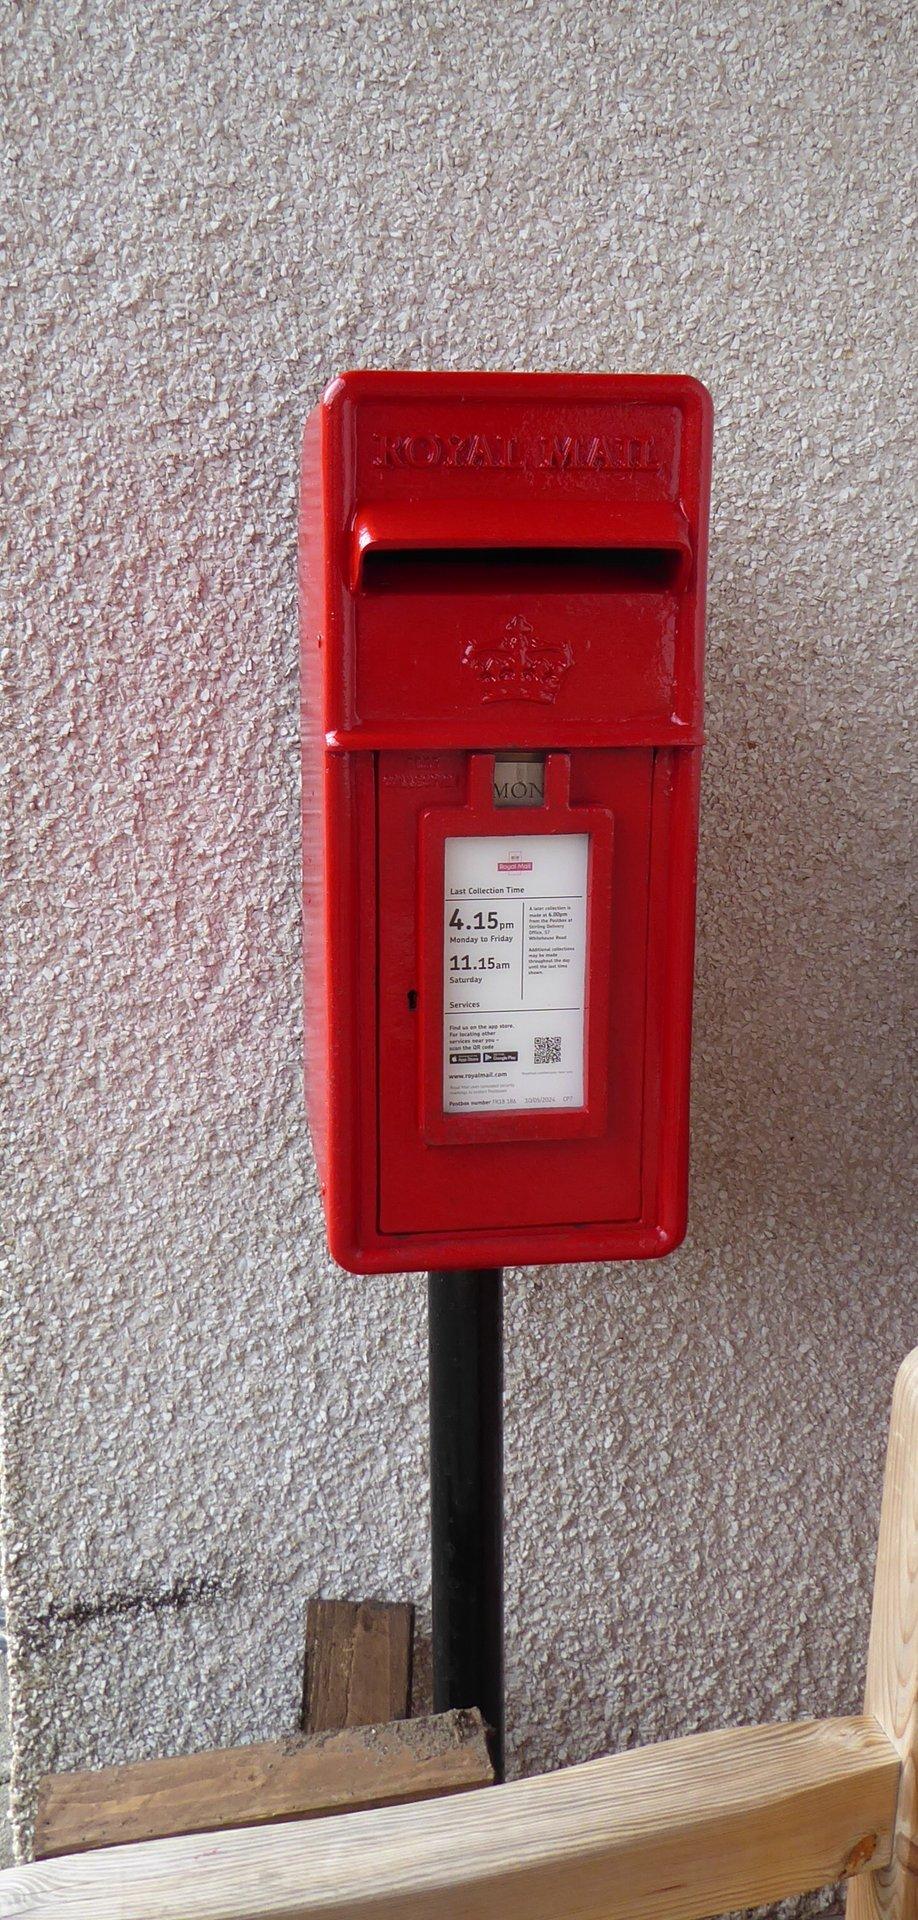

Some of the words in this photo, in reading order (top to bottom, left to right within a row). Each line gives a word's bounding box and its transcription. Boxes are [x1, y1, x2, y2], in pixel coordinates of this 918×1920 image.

[372, 433, 527, 469] ROYAL
[538, 435, 662, 470] MAIL
[493, 781, 544, 799] MON
[468, 887, 504, 895] Collection
[506, 886, 525, 894] Time
[449, 908, 514, 931] 4.15pm
[450, 936, 478, 944] Monday
[490, 935, 513, 943] Friday
[450, 954, 510, 971] 11.15am
[449, 976, 483, 984] Saturday
[449, 1001, 480, 1009] Services
[448, 1071, 508, 1079] www.royalmail.com
